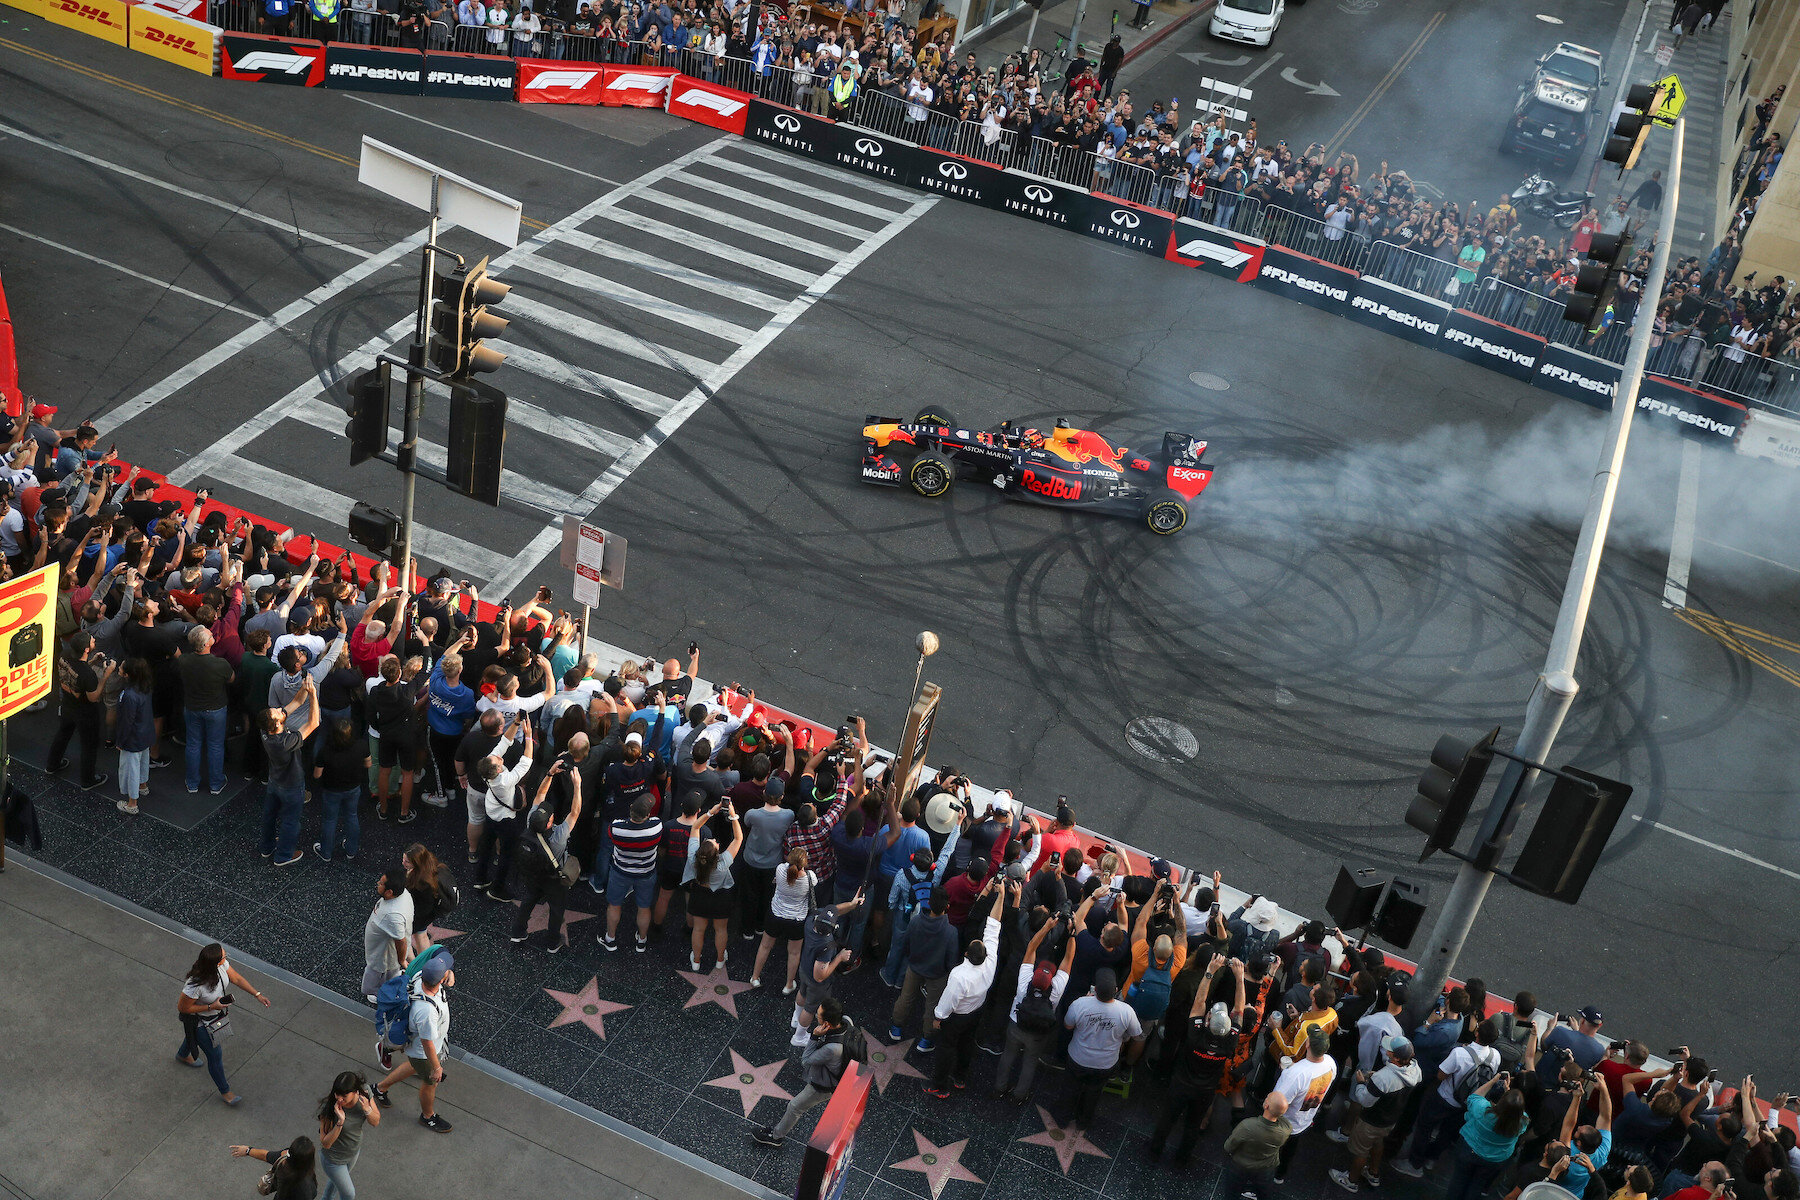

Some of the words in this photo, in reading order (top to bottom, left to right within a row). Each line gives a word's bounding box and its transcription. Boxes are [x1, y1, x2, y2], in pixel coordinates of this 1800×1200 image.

[60, 0, 112, 26] DHL
[145, 27, 198, 56] DHL
[329, 64, 419, 82] #F1Festival
[427, 71, 512, 88] #F1Festival
[757, 128, 813, 152] INFINITI
[837, 152, 896, 176] INFINITI
[921, 176, 981, 199] INFINITI
[1006, 199, 1067, 223] INFINITI
[1091, 224, 1153, 249] INFINITI
[1261, 264, 1348, 302] #F1Festival
[1351, 296, 1440, 335] #F1Festival
[1444, 328, 1536, 368] #F1Festival
[1540, 363, 1618, 397] #F1Festiv
[1638, 396, 1736, 437] #F1Festival
[962, 446, 985, 455] ASTON
[986, 450, 1012, 460] MARTIN
[863, 468, 890, 479] Mobil
[1083, 469, 1119, 478] HONDA
[1173, 468, 1205, 481] Exxon
